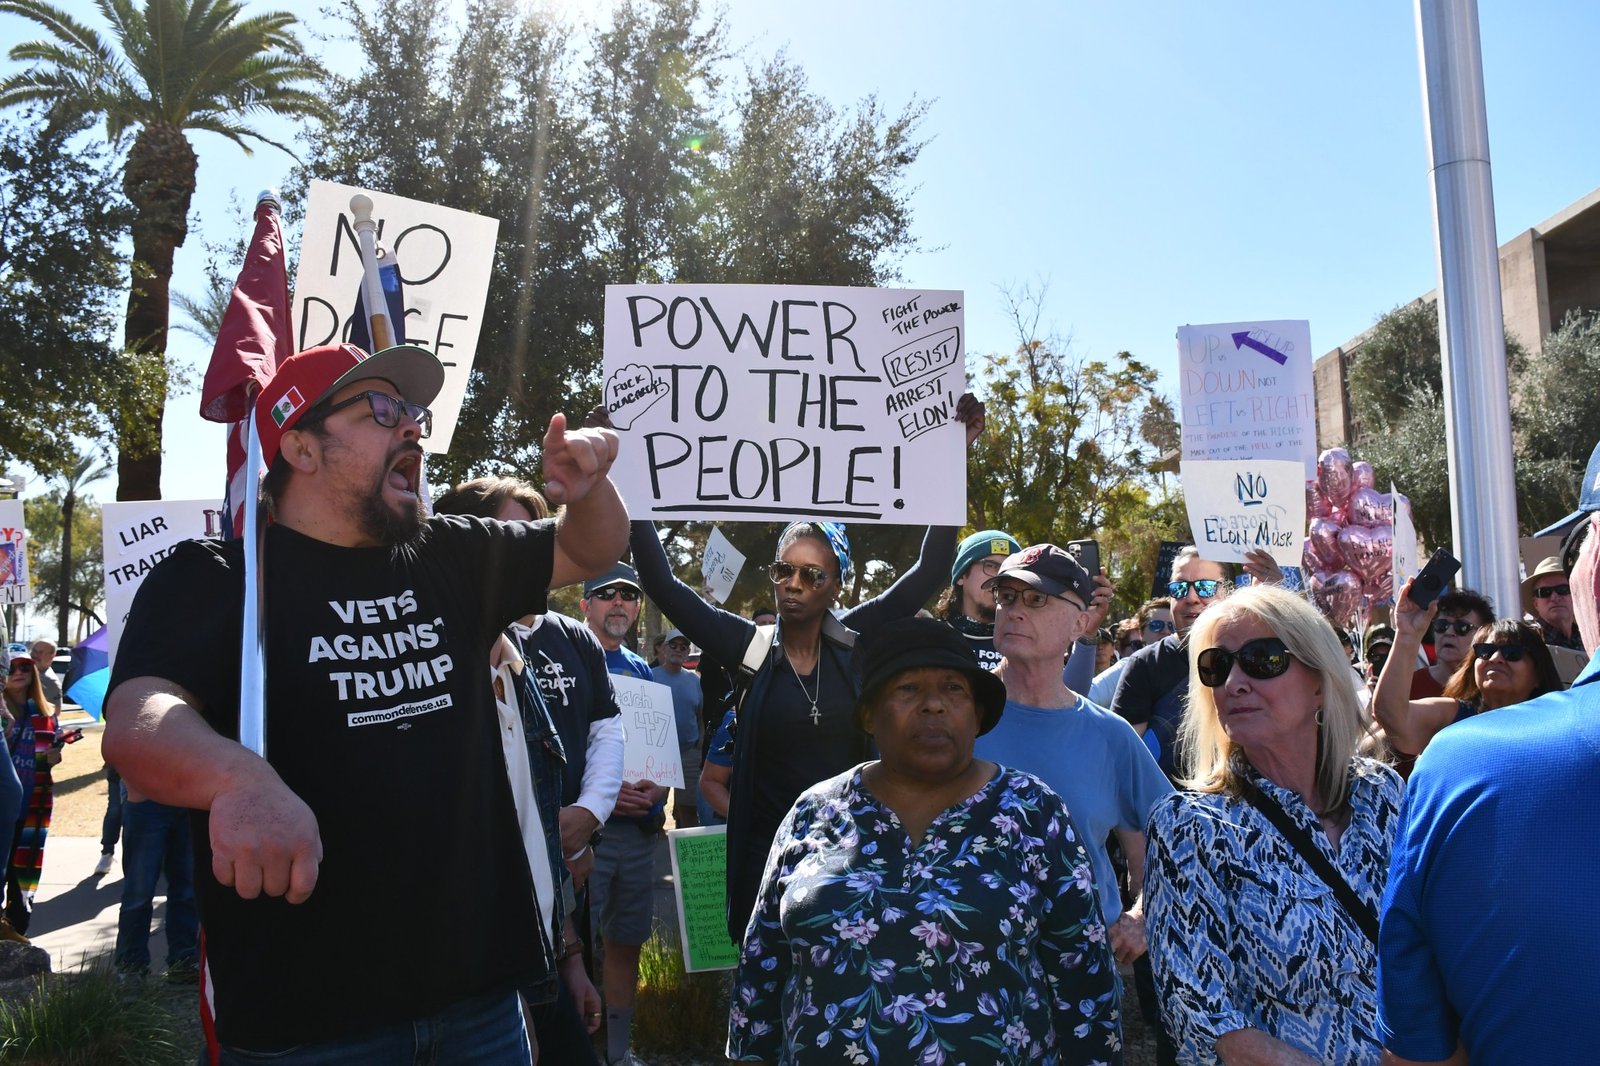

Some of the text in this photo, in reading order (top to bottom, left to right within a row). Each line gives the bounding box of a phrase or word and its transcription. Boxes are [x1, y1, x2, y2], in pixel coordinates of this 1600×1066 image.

[330, 213, 451, 285] NO
[882, 295, 922, 323] FIGHT
[892, 302, 962, 336] THE POWER
[626, 295, 866, 372] POWER
[1188, 336, 1220, 364] UP
[889, 335, 954, 382] RESIST
[613, 373, 645, 397] FUCK
[653, 364, 881, 432] TO THE
[885, 372, 948, 416] ARREST
[1185, 370, 1277, 395] DOWN NOT
[898, 389, 957, 439] ELON!
[1183, 403, 1237, 426] LEFT
[1249, 395, 1309, 422] RIGHT
[1288, 439, 1304, 447] THE
[644, 432, 906, 510] PEOPLE!
[1234, 470, 1267, 500] NO
[118, 516, 169, 547] LIAR
[328, 589, 418, 625] VETS
[329, 653, 454, 701] TRUMP
[541, 662, 564, 675] OR
[614, 685, 652, 708] each
[634, 711, 672, 747] 47
